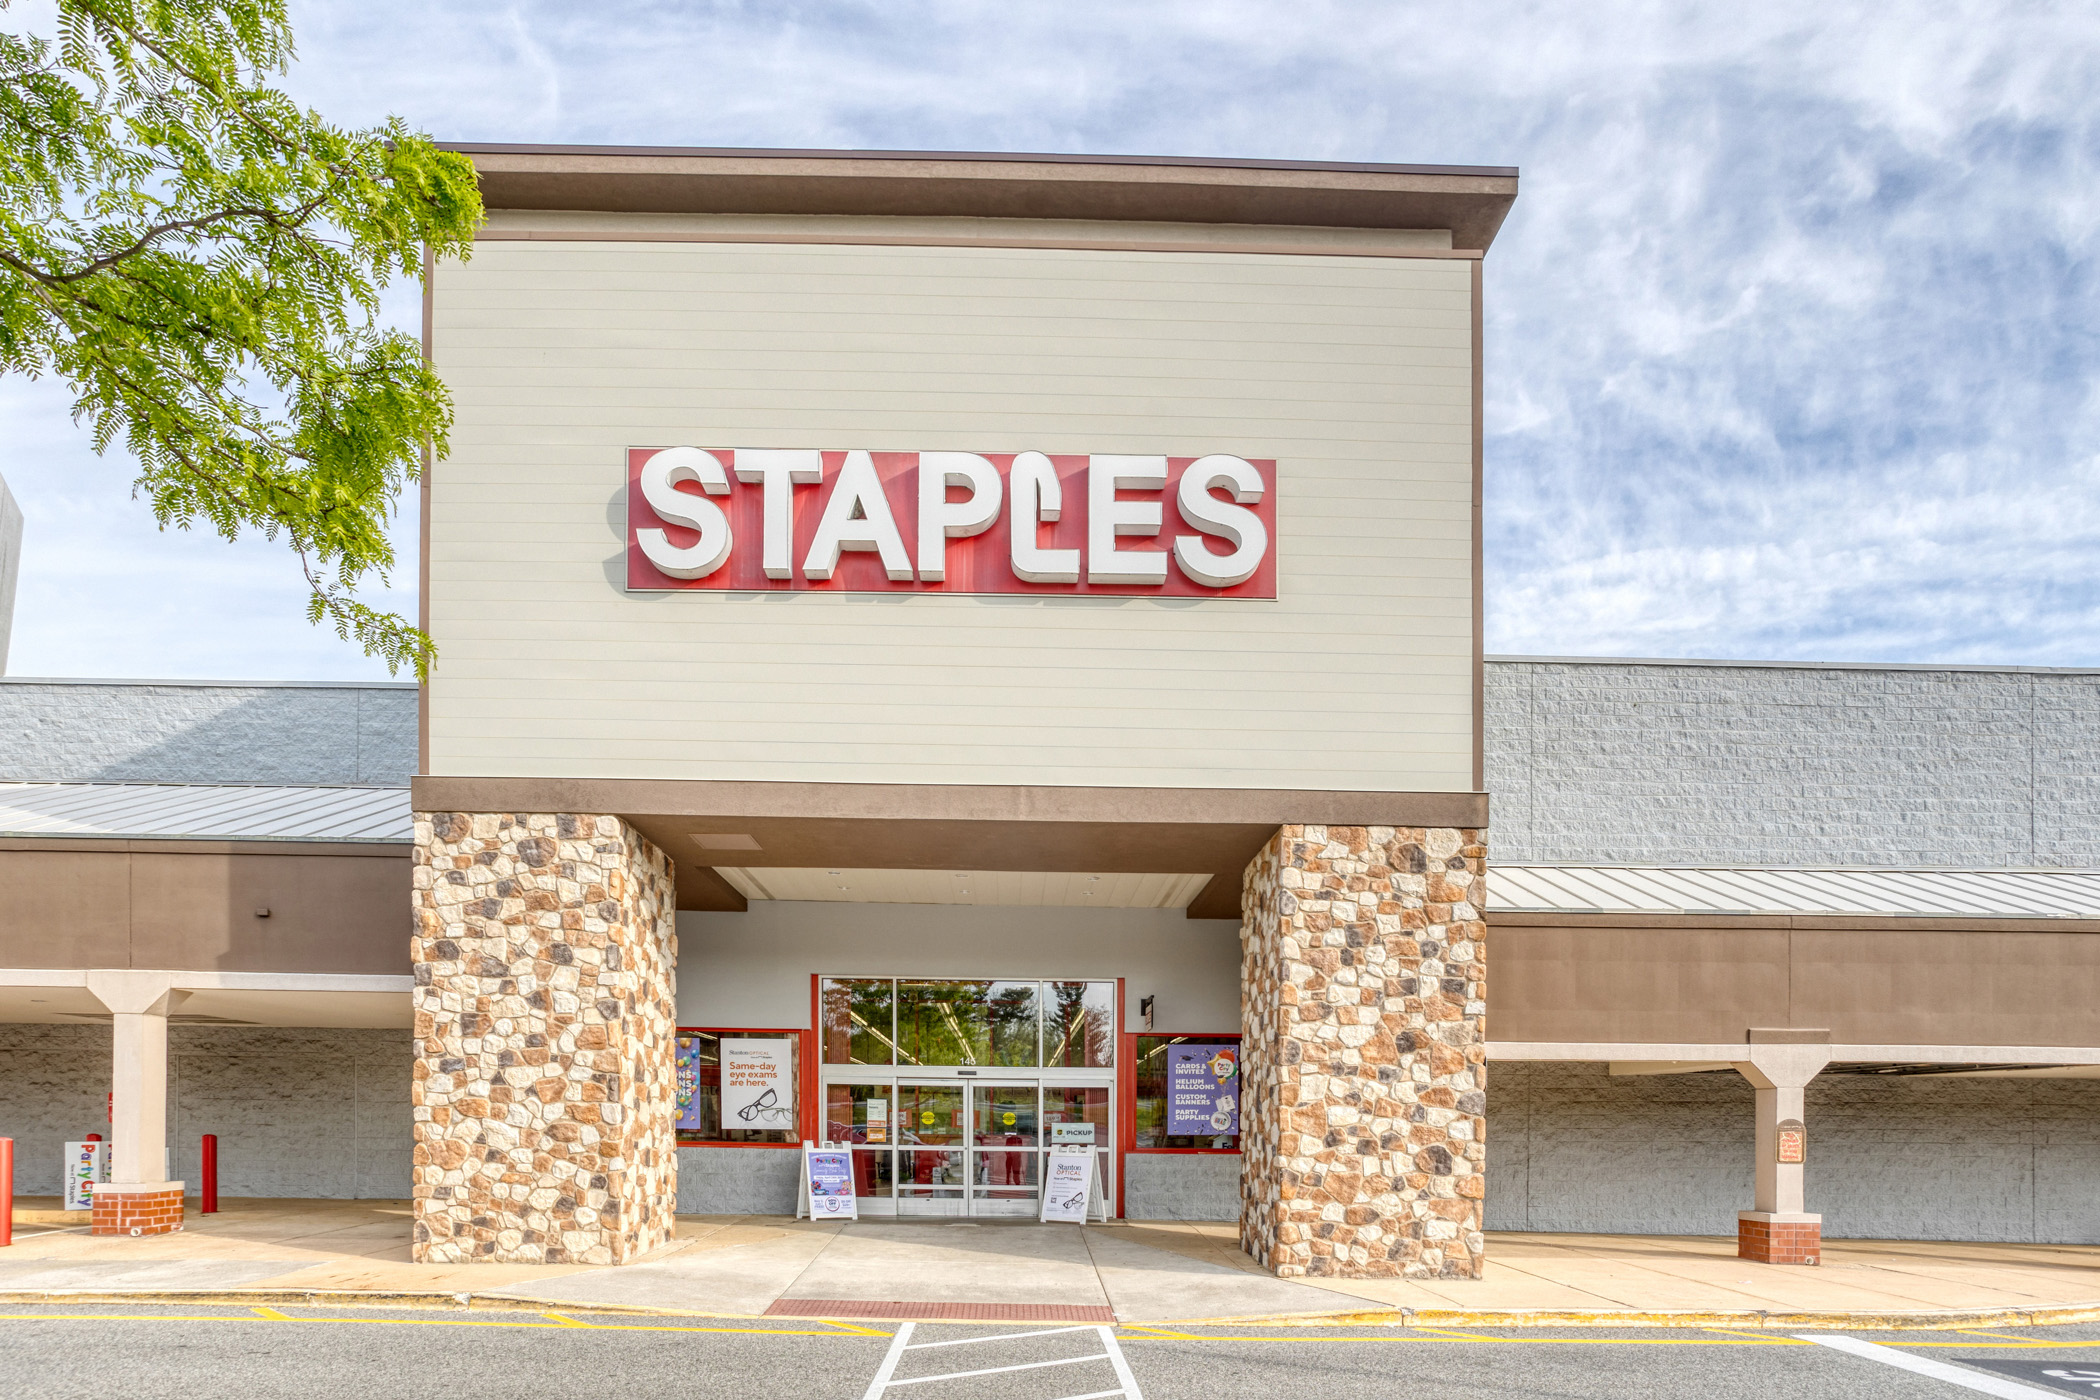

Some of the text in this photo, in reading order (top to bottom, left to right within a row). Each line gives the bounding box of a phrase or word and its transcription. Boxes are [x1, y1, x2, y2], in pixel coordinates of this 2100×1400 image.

[636, 446, 1268, 587] STAPLES
[960, 1057, 976, 1065] 145
[729, 1062, 777, 1072] Same-day
[729, 1072, 746, 1080] eye
[746, 1079, 769, 1087] here.
[77, 1144, 96, 1179] Party
[1057, 1163, 1082, 1171] Stanton
[68, 1184, 76, 1204] Staples
[77, 1180, 95, 1207] City
